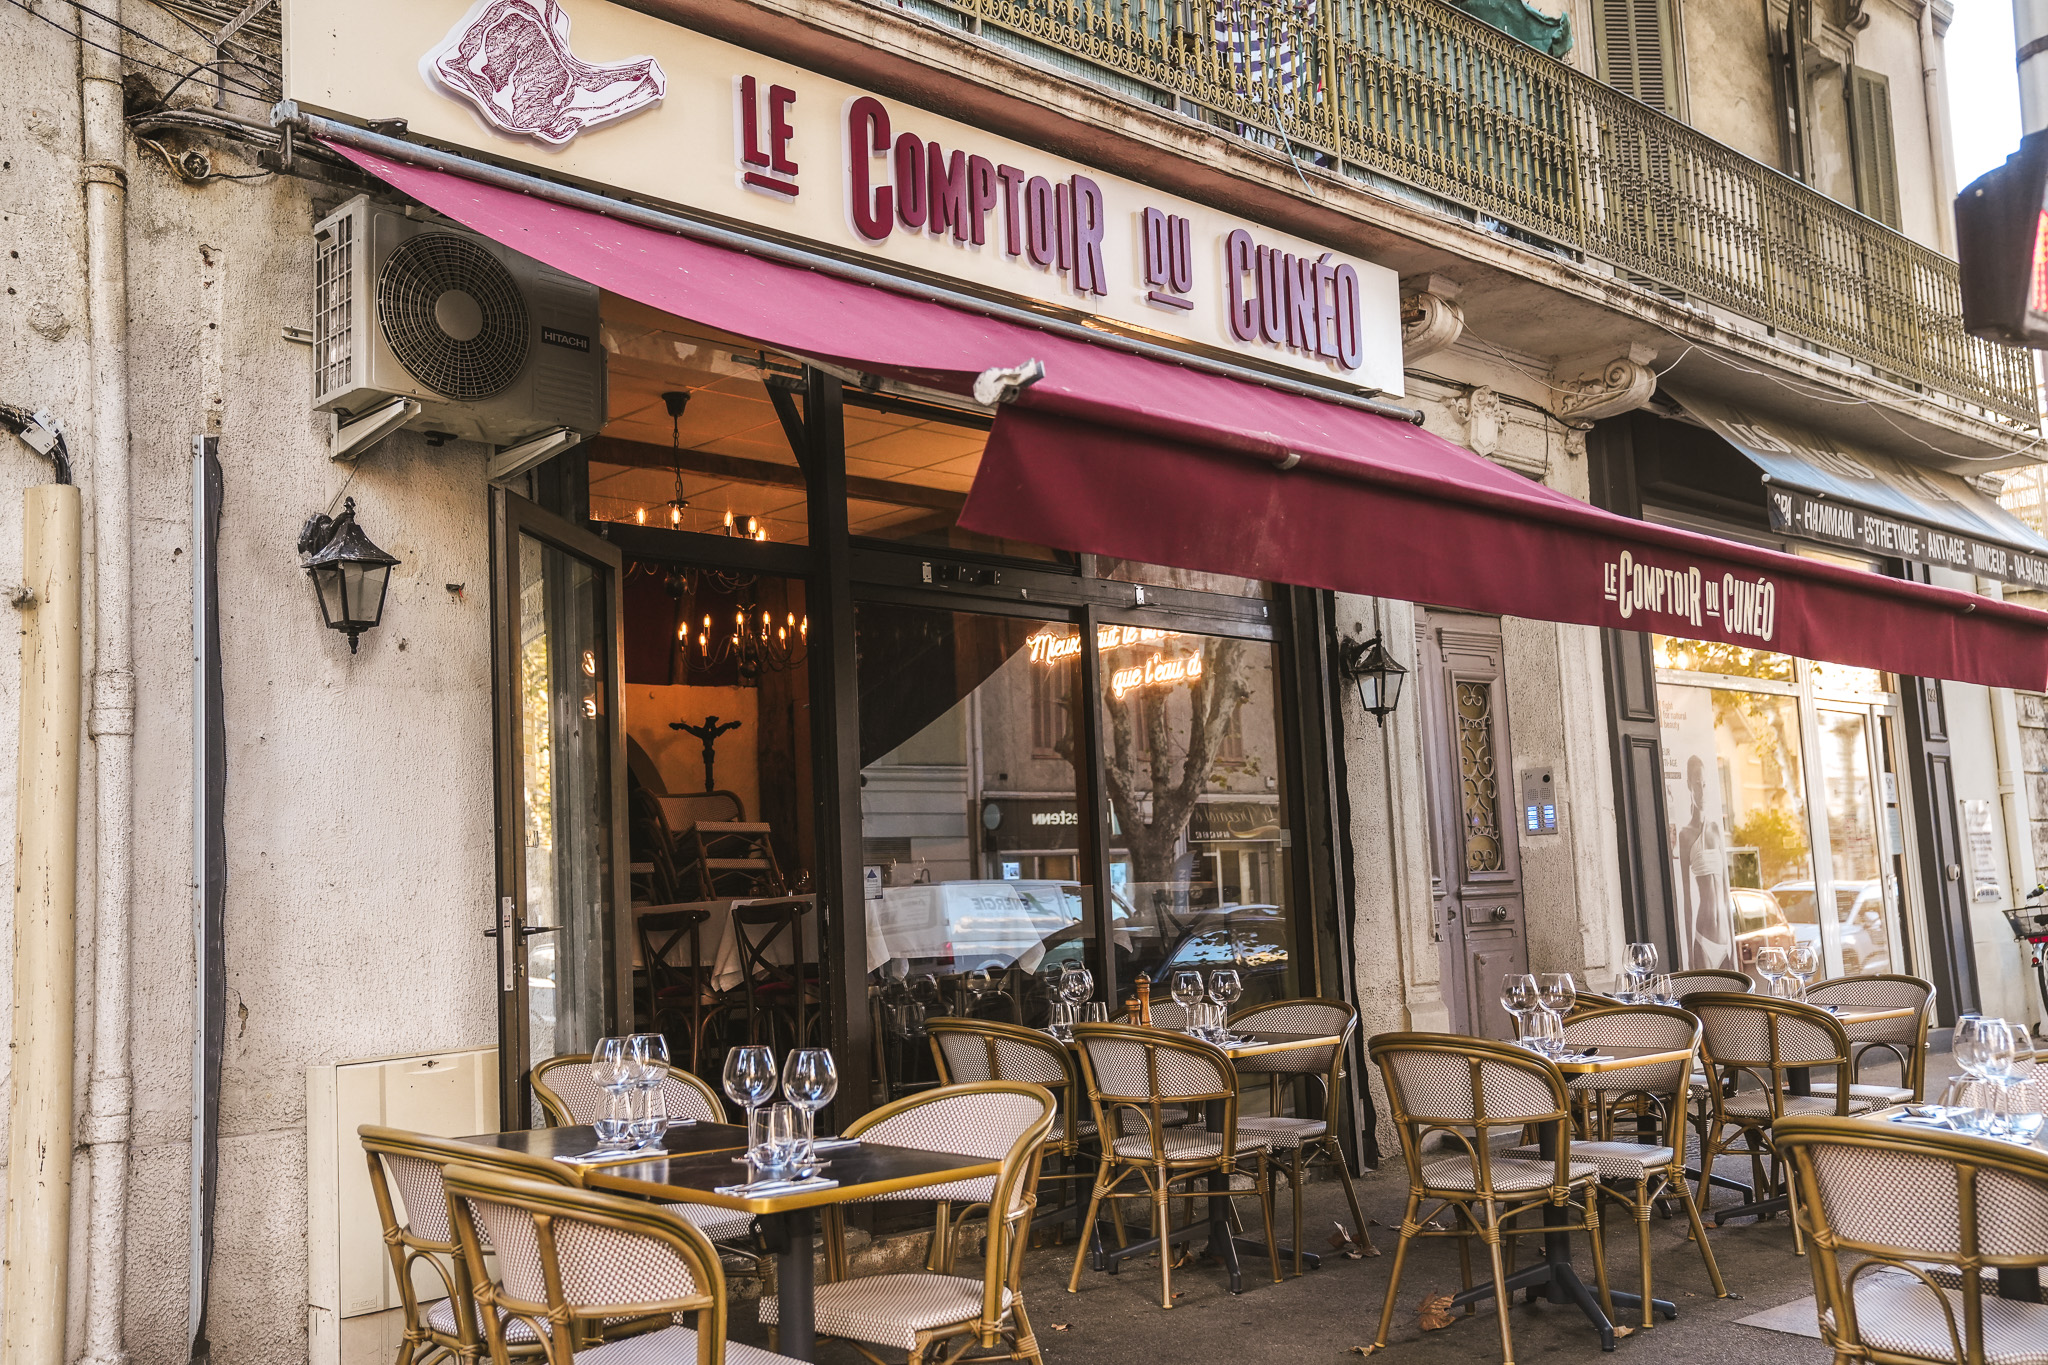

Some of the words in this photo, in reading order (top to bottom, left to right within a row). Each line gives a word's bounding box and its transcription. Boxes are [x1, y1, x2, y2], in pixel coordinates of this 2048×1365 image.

[741, 75, 799, 176] LE
[850, 96, 1107, 296] COMPTOIR
[1144, 206, 1193, 293] DU
[1227, 228, 1363, 370] CUNÉO
[544, 331, 587, 348] HITACHI
[1804, 500, 1855, 539] HAMMAM
[1864, 515, 1920, 555] ESTHETIQUE
[1972, 543, 2008, 576] MINCEUR
[1604, 562, 1617, 594] LE
[1619, 550, 1702, 627] COMPTOIR
[1706, 580, 1719, 611] DU
[1723, 572, 1775, 642] CUNÉO
[1027, 634, 1082, 668] Mieux
[1112, 667, 1142, 698] que
[1144, 655, 1185, 684] l'eau
